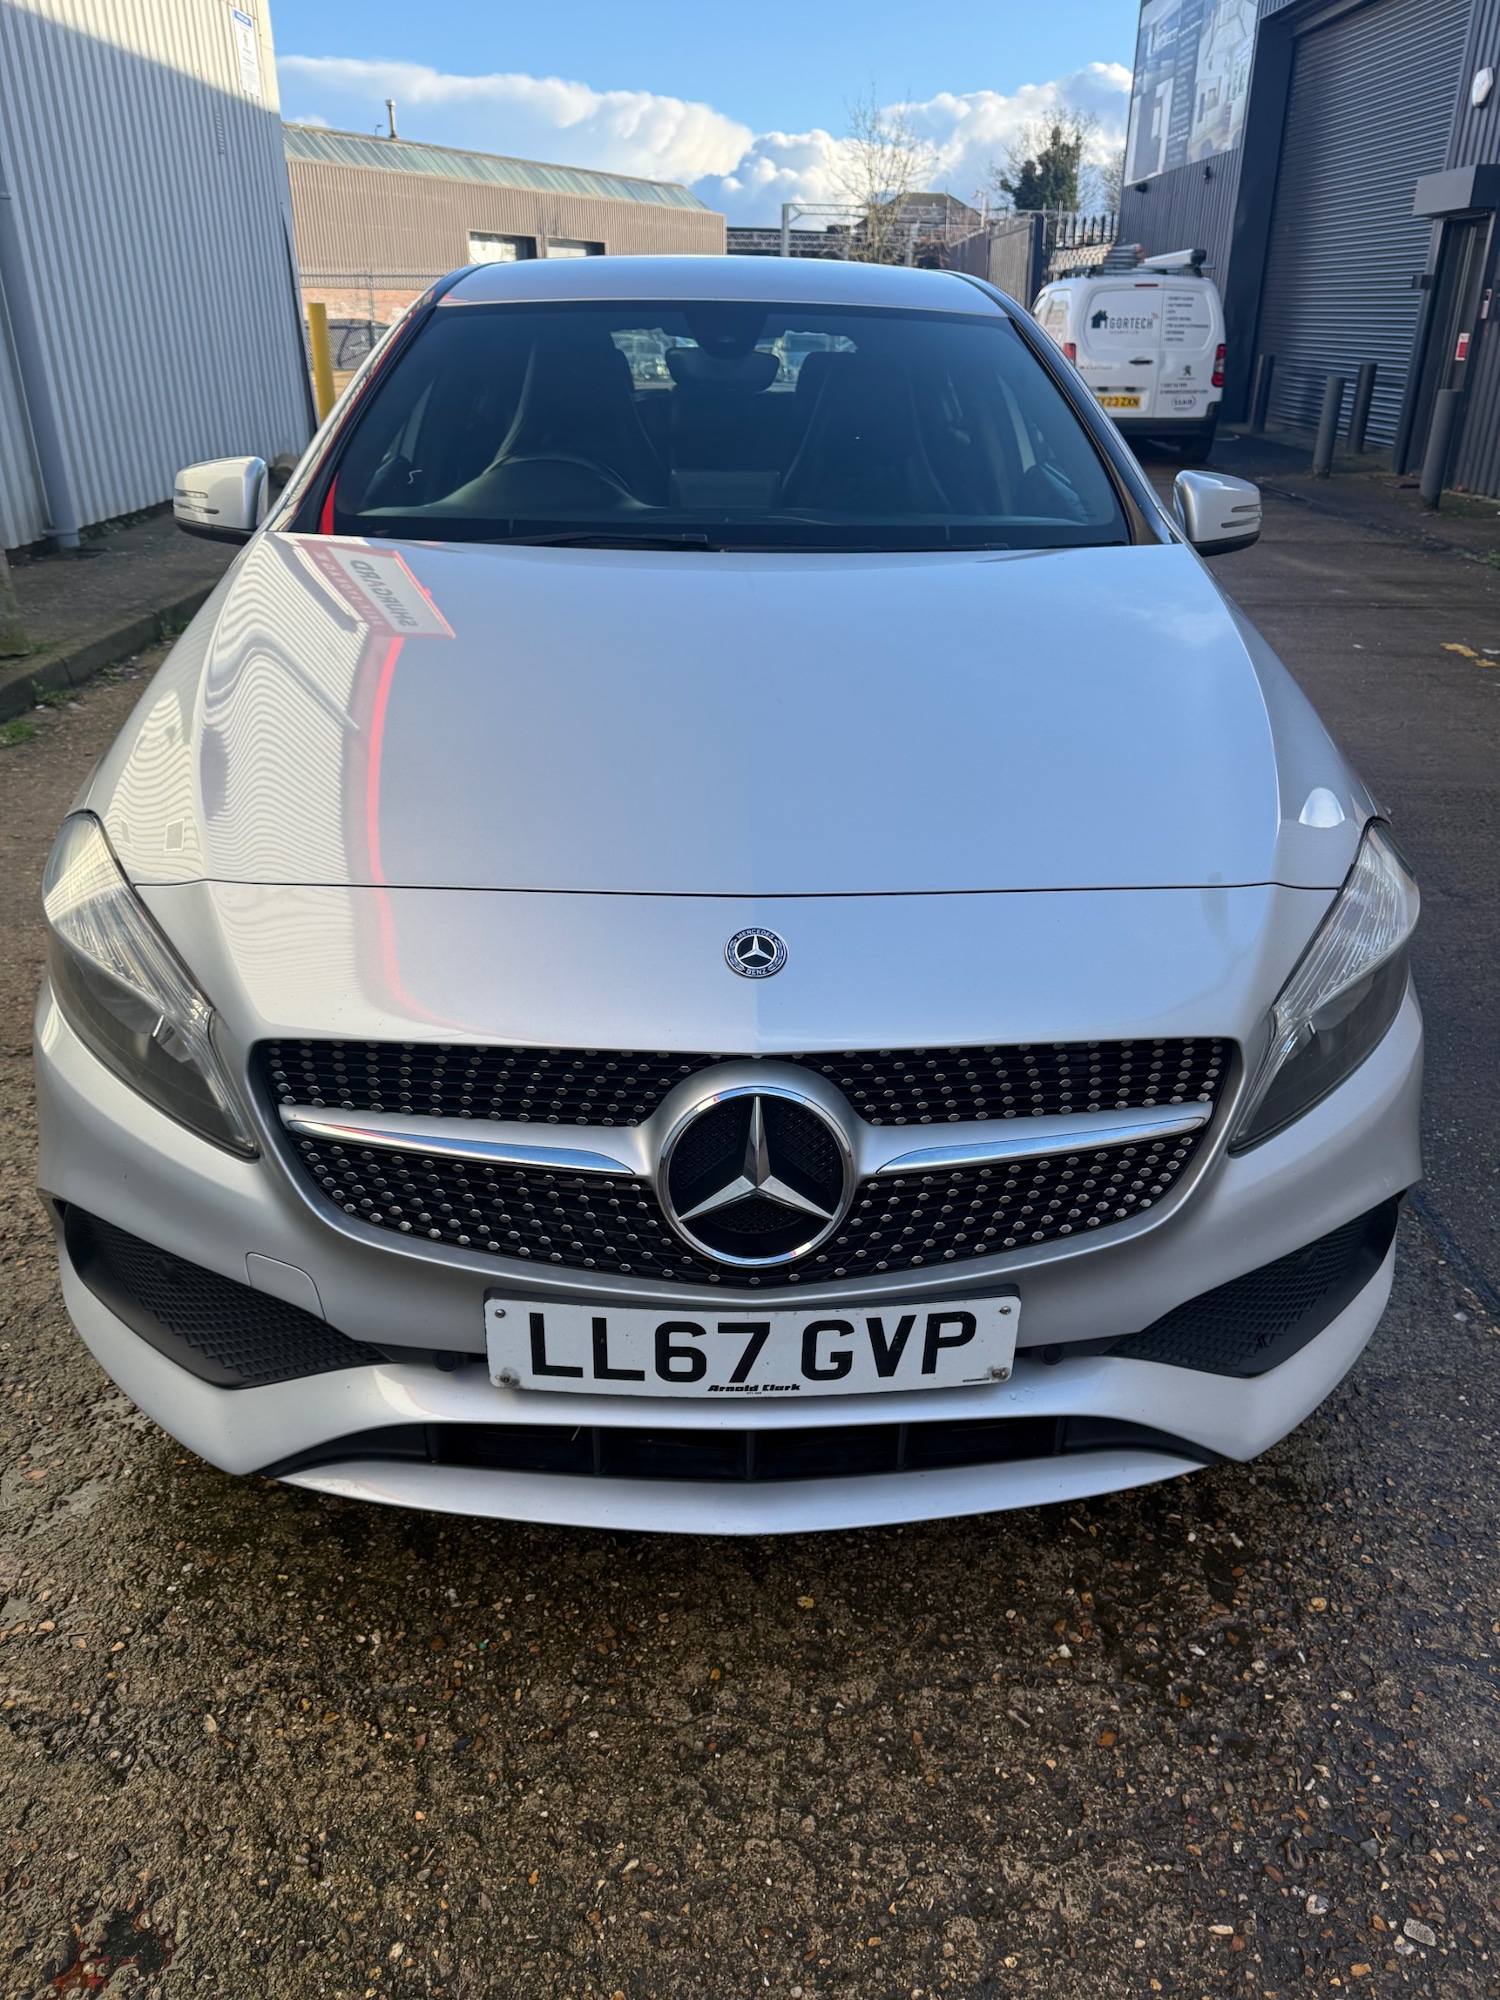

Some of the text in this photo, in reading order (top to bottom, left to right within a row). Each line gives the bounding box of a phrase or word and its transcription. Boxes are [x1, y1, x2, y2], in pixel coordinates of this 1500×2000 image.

[1109, 317, 1153, 329] GORTECH
[1098, 396, 1117, 407] Y23
[736, 929, 775, 939] MERCEDES
[529, 1311, 977, 1384] LL67 GVP
[707, 1383, 801, 1392] Arnold Clark
